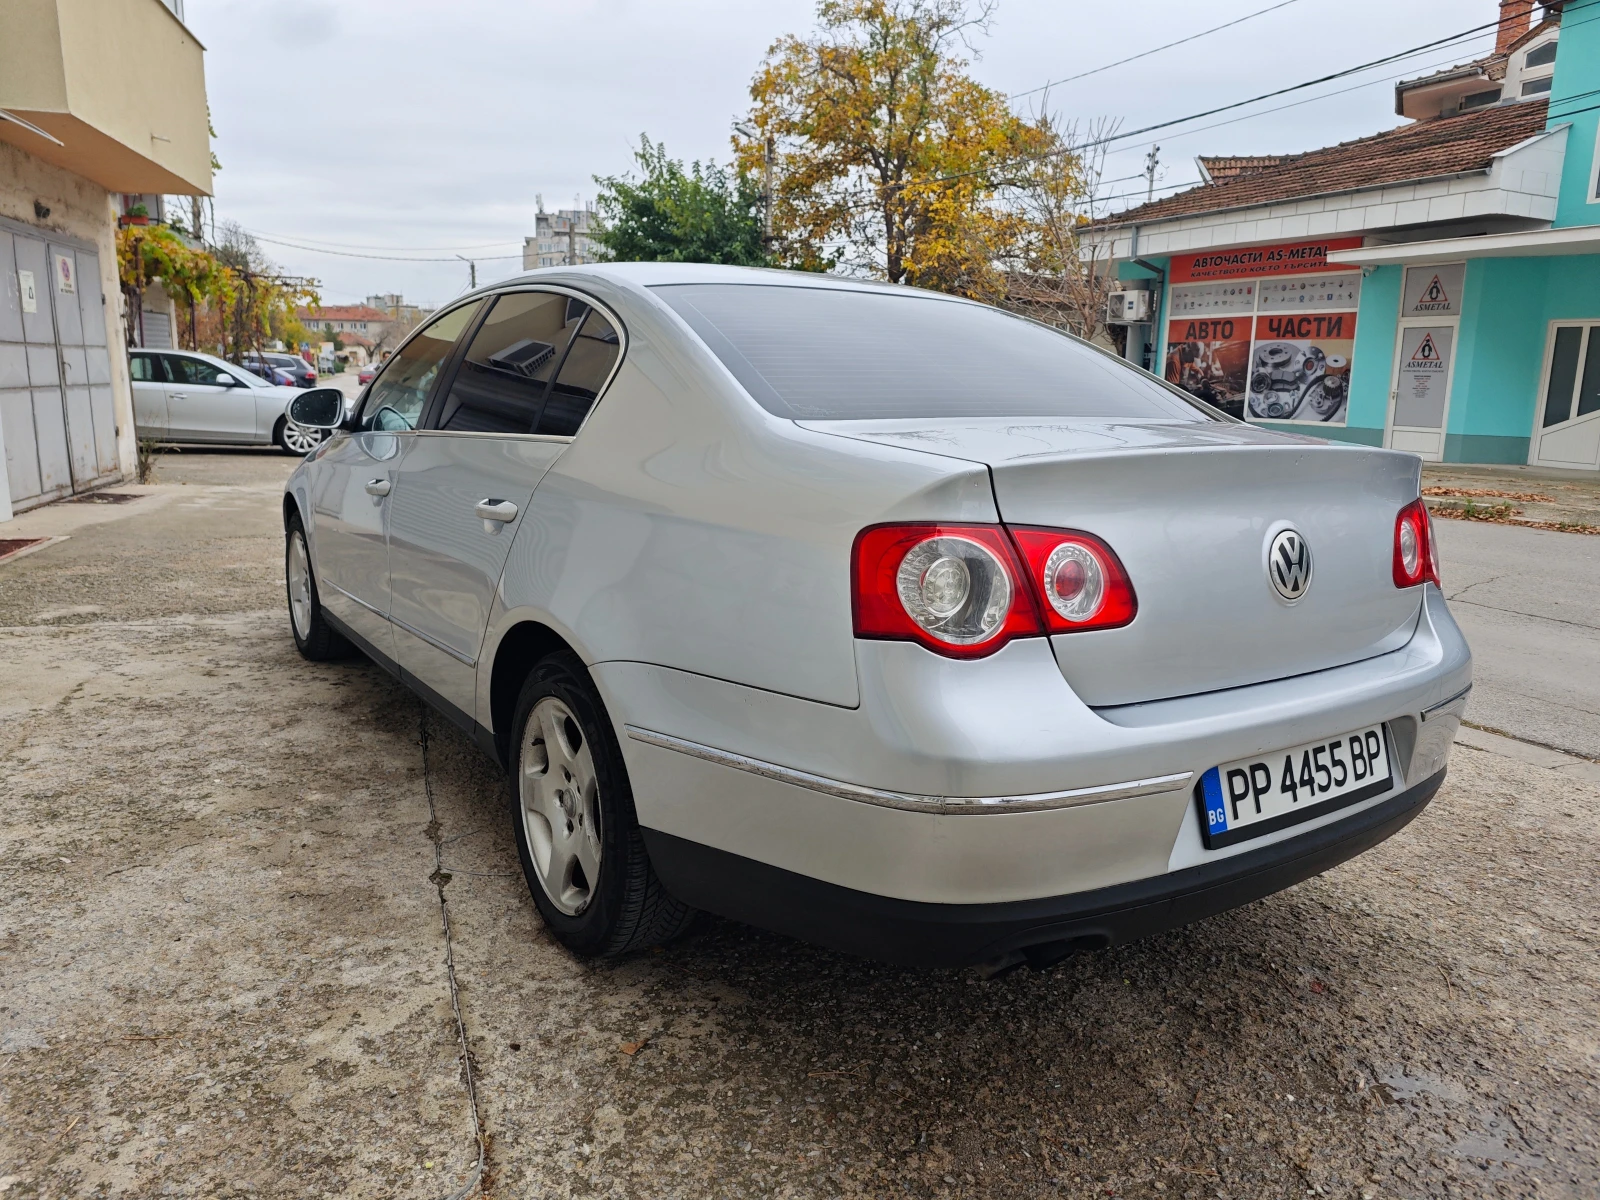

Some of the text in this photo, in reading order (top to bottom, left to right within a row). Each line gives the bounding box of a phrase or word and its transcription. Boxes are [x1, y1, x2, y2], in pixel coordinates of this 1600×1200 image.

[1192, 245, 1328, 269] АВТОЧАСТИ AS-METAL
[1190, 261, 1329, 278] КАЧЕСТВОТО КОЕТО ТЪРСИТЕ
[1412, 302, 1452, 312] ASMETAL
[1185, 320, 1234, 340] АВТО
[1268, 316, 1343, 338] ЧАСТИ
[1404, 360, 1444, 369] ASMETAL
[1226, 730, 1381, 821] PP 4455 BP
[1208, 808, 1225, 826] BG
